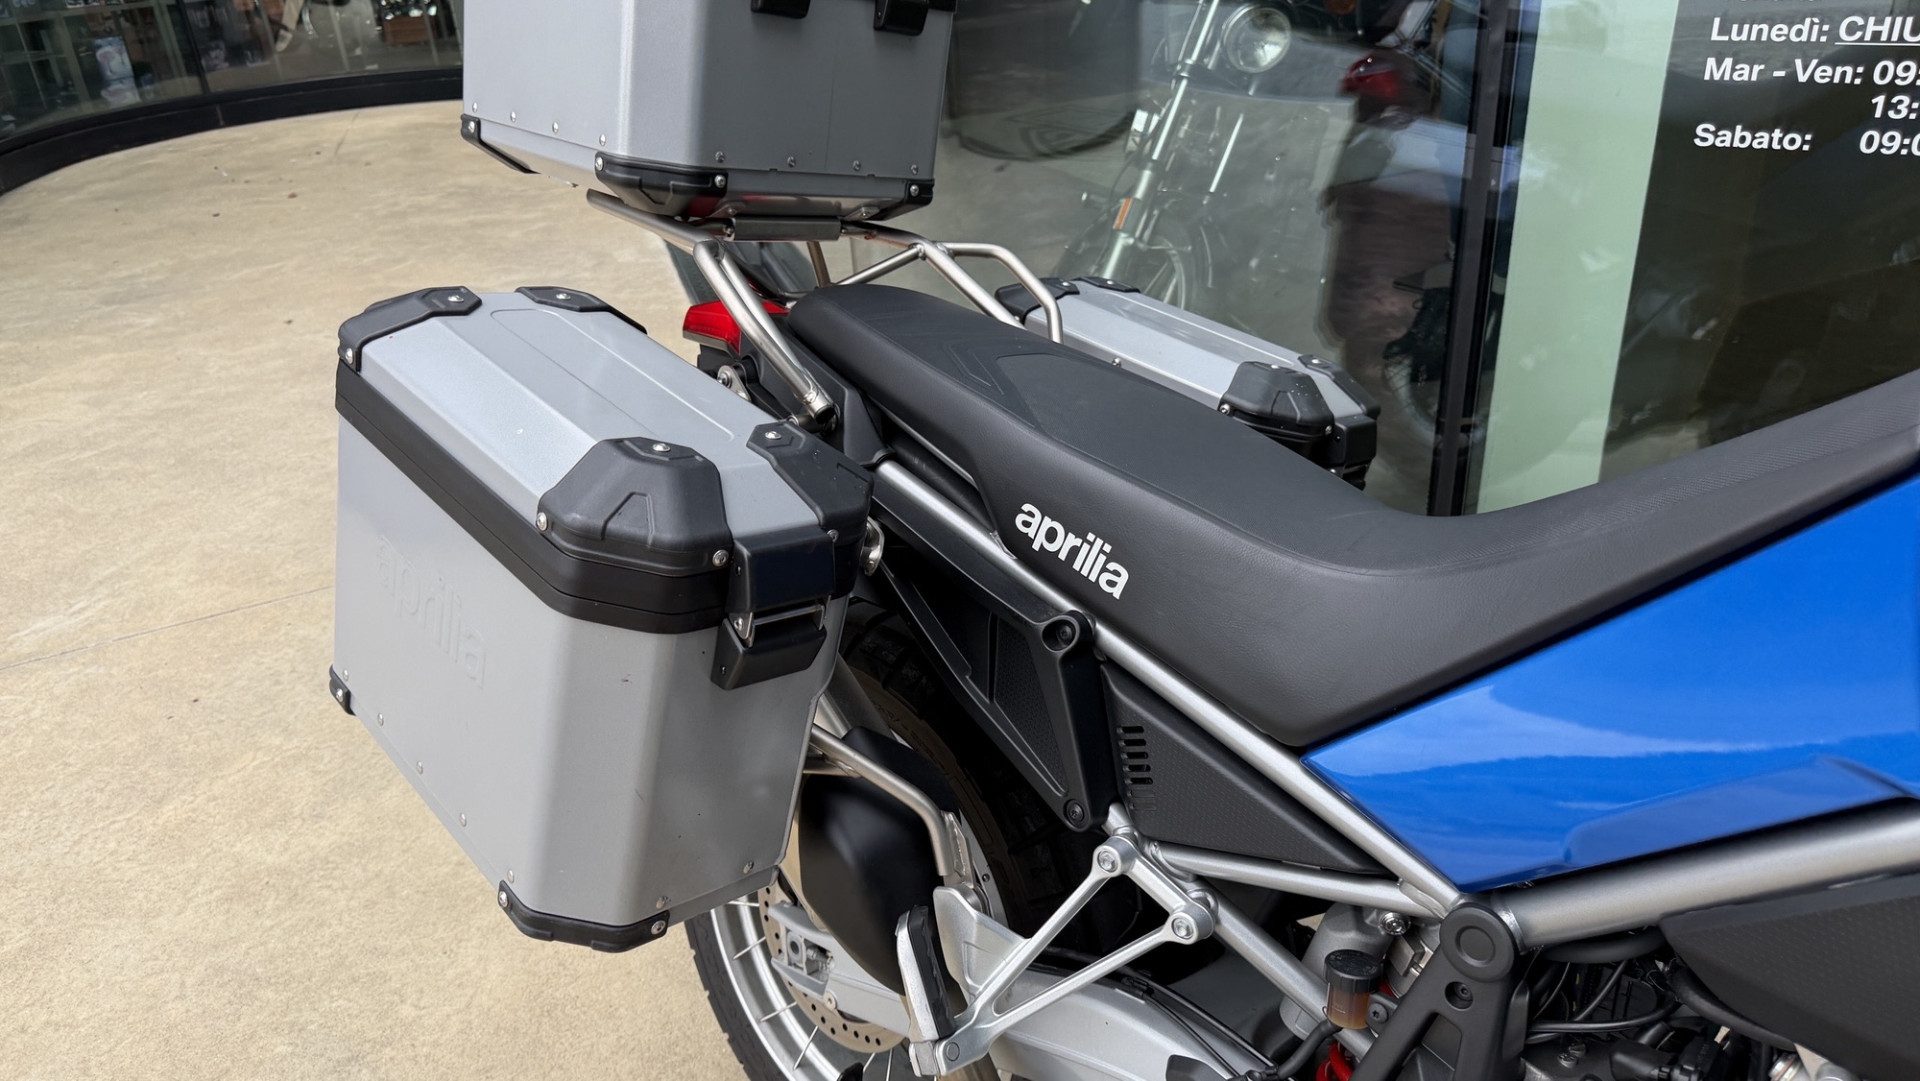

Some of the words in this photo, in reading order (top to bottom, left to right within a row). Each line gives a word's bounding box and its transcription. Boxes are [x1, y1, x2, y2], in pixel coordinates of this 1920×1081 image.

[1710, 17, 1829, 42] Lunedì:
[1704, 57, 1765, 81] Mar
[1794, 59, 1864, 85] Ven:
[1871, 95, 1919, 120] 13:
[1693, 123, 1812, 151] Sabato:
[1015, 503, 1129, 600] aprilia
[376, 535, 487, 690] aprilia
